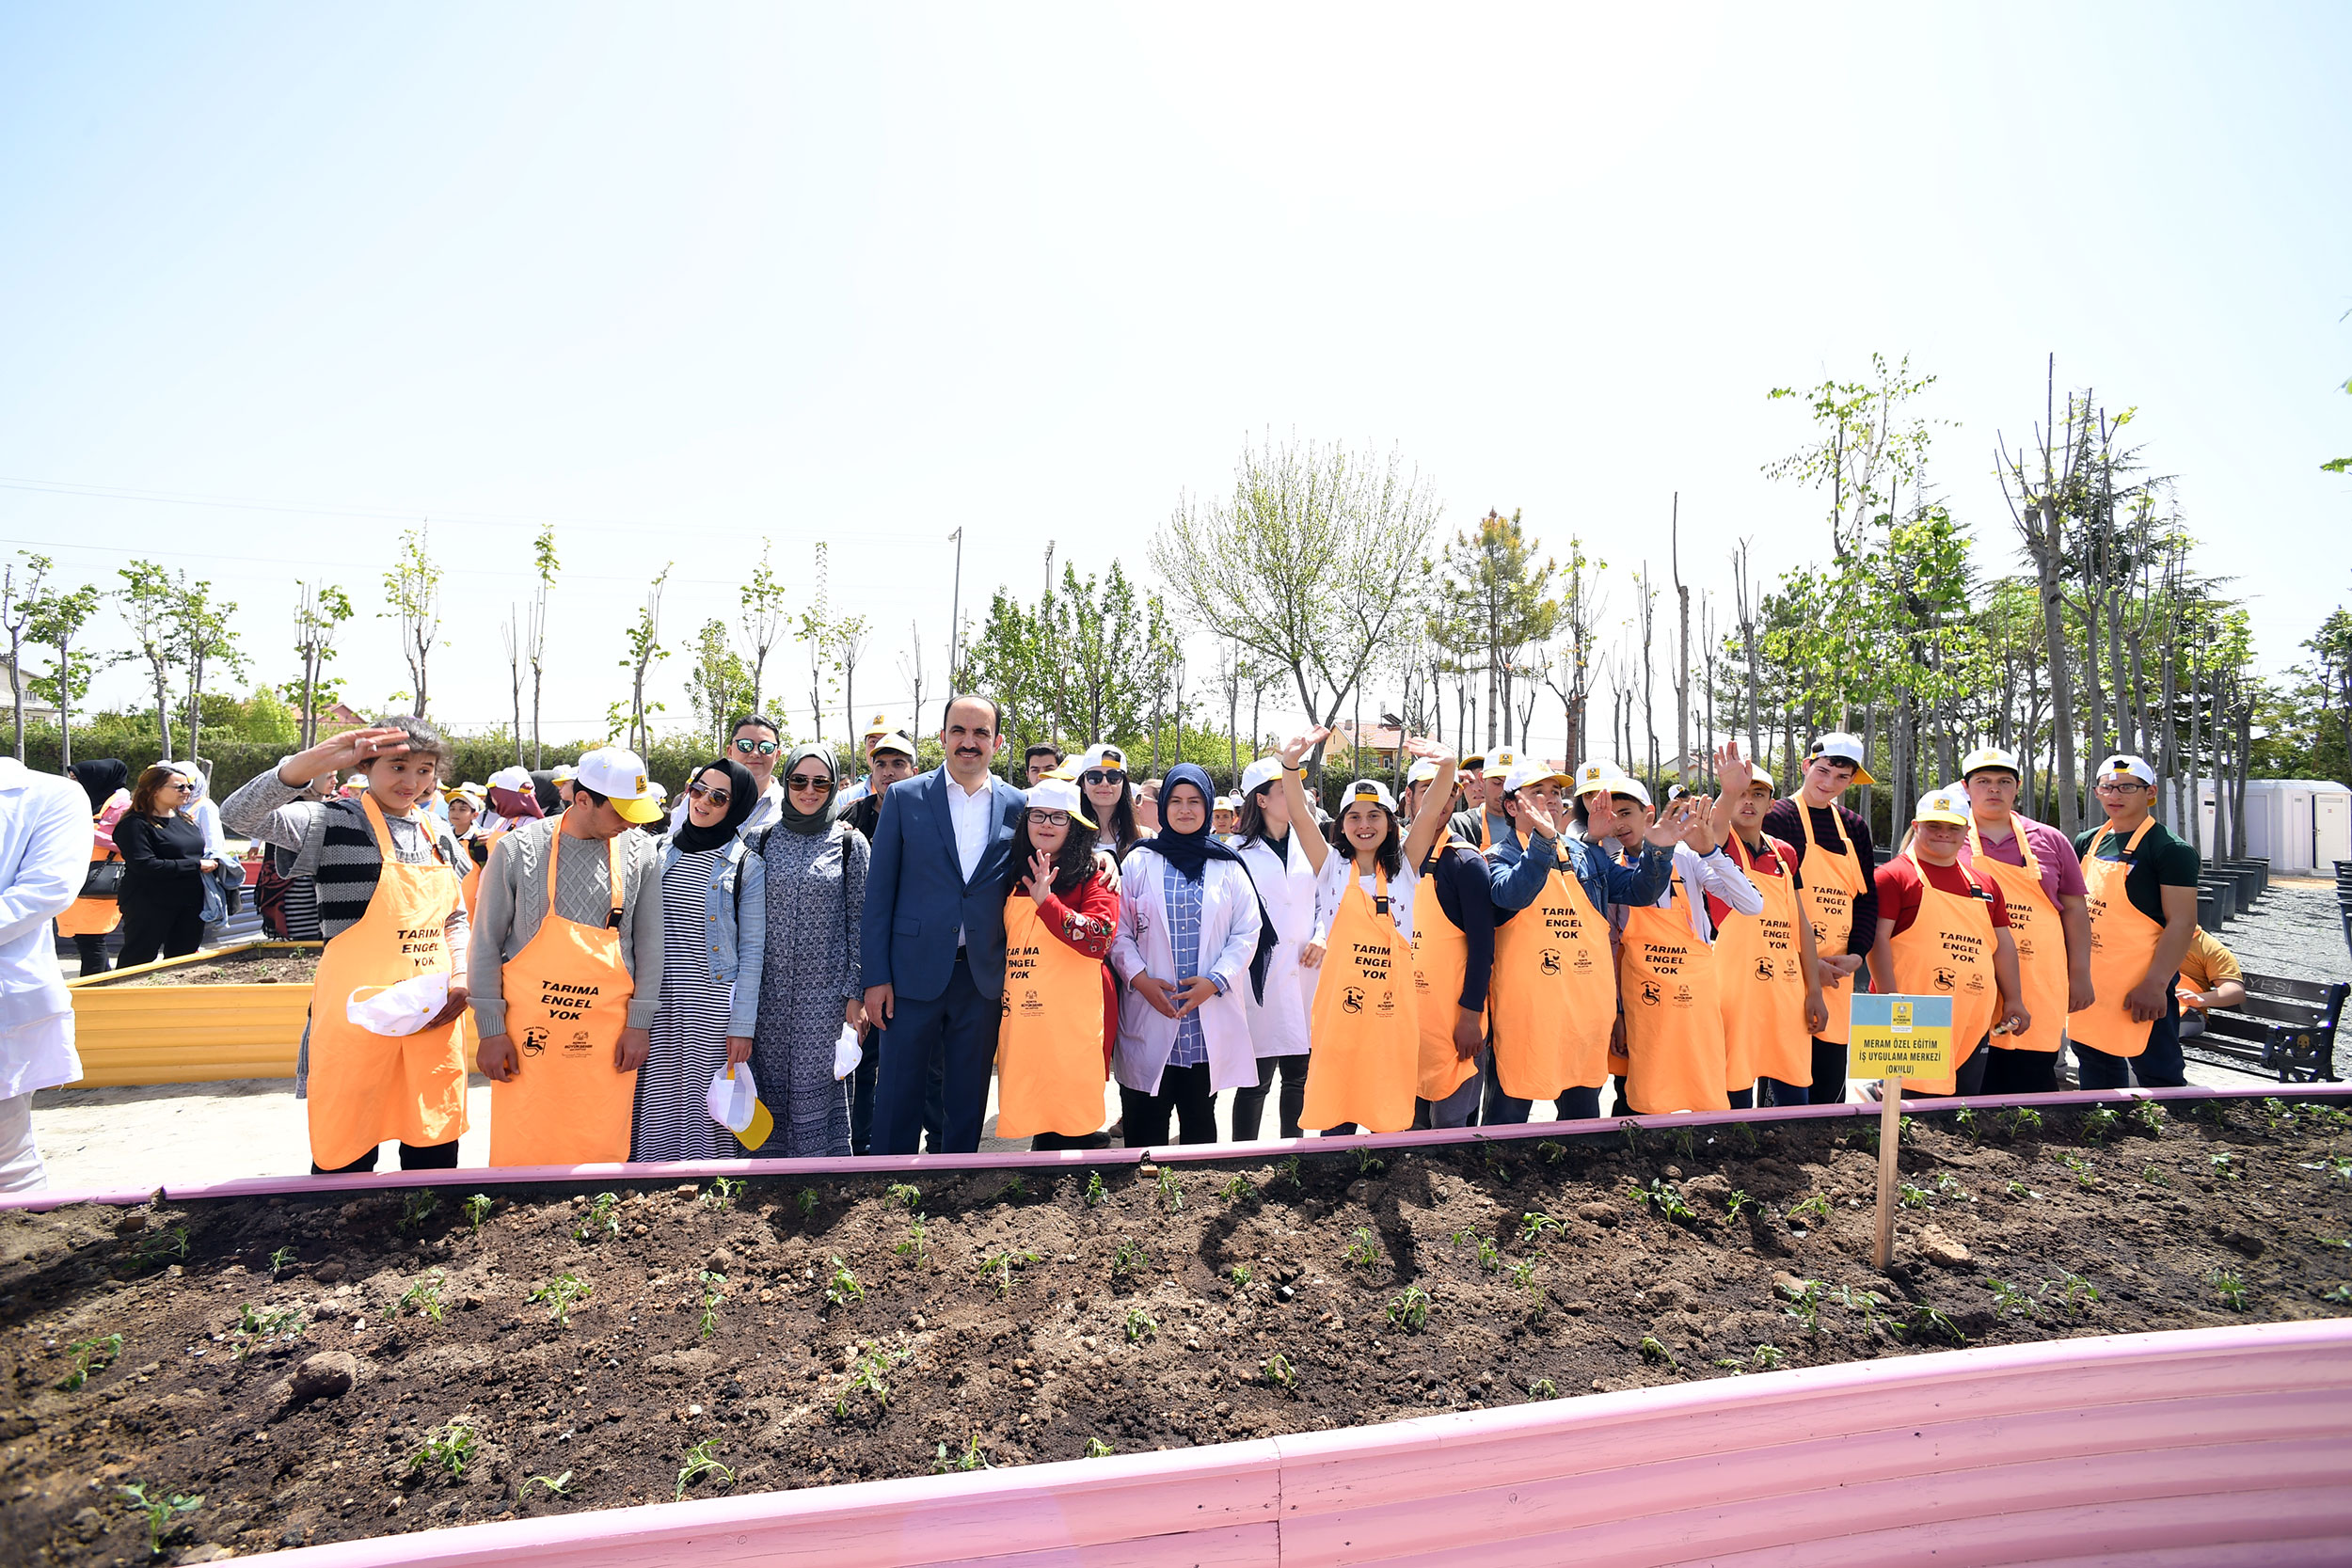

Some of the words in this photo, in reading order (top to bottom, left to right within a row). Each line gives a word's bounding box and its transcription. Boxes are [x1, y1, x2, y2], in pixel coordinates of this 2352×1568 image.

[1816, 896, 1847, 907] ENGEL
[1541, 908, 1578, 916] TARIM
[1823, 907, 1843, 915] YOK
[2006, 903, 2032, 912] RIMA
[2007, 911, 2031, 922] GEL
[2009, 922, 2026, 930] OK
[1554, 930, 1579, 939] YOK
[1763, 929, 1790, 940] ENGEL
[1939, 931, 1982, 946] TARIMA
[402, 942, 438, 954] ENGEL
[1353, 943, 1391, 956] TARIM
[1644, 943, 1688, 955] TARIMA
[1769, 941, 1788, 949] YOK
[1943, 942, 1980, 956] ENGEL
[1006, 946, 1040, 957] TARMA
[414, 956, 435, 967] YOK
[1645, 954, 1685, 965] ENGEL
[1951, 953, 1976, 964] YOK
[1009, 971, 1030, 979] YOK
[1362, 969, 1388, 980] YOK
[1653, 966, 1678, 975] YOK
[542, 980, 599, 996] TARIMA
[2243, 974, 2294, 994] İYESİ
[541, 994, 593, 1009] ENGEL
[548, 1008, 582, 1021] YOK
[1864, 1039, 1891, 1049] MERAM
[1893, 1037, 1911, 1049] ÖZEL
[1913, 1038, 1938, 1049] EĞİTİM
[1859, 1050, 1867, 1063] İŞ
[1868, 1052, 1908, 1061] UYGULAMA
[1910, 1051, 1942, 1061] MERKEZİ
[1885, 1064, 1915, 1076] (OKULU)
